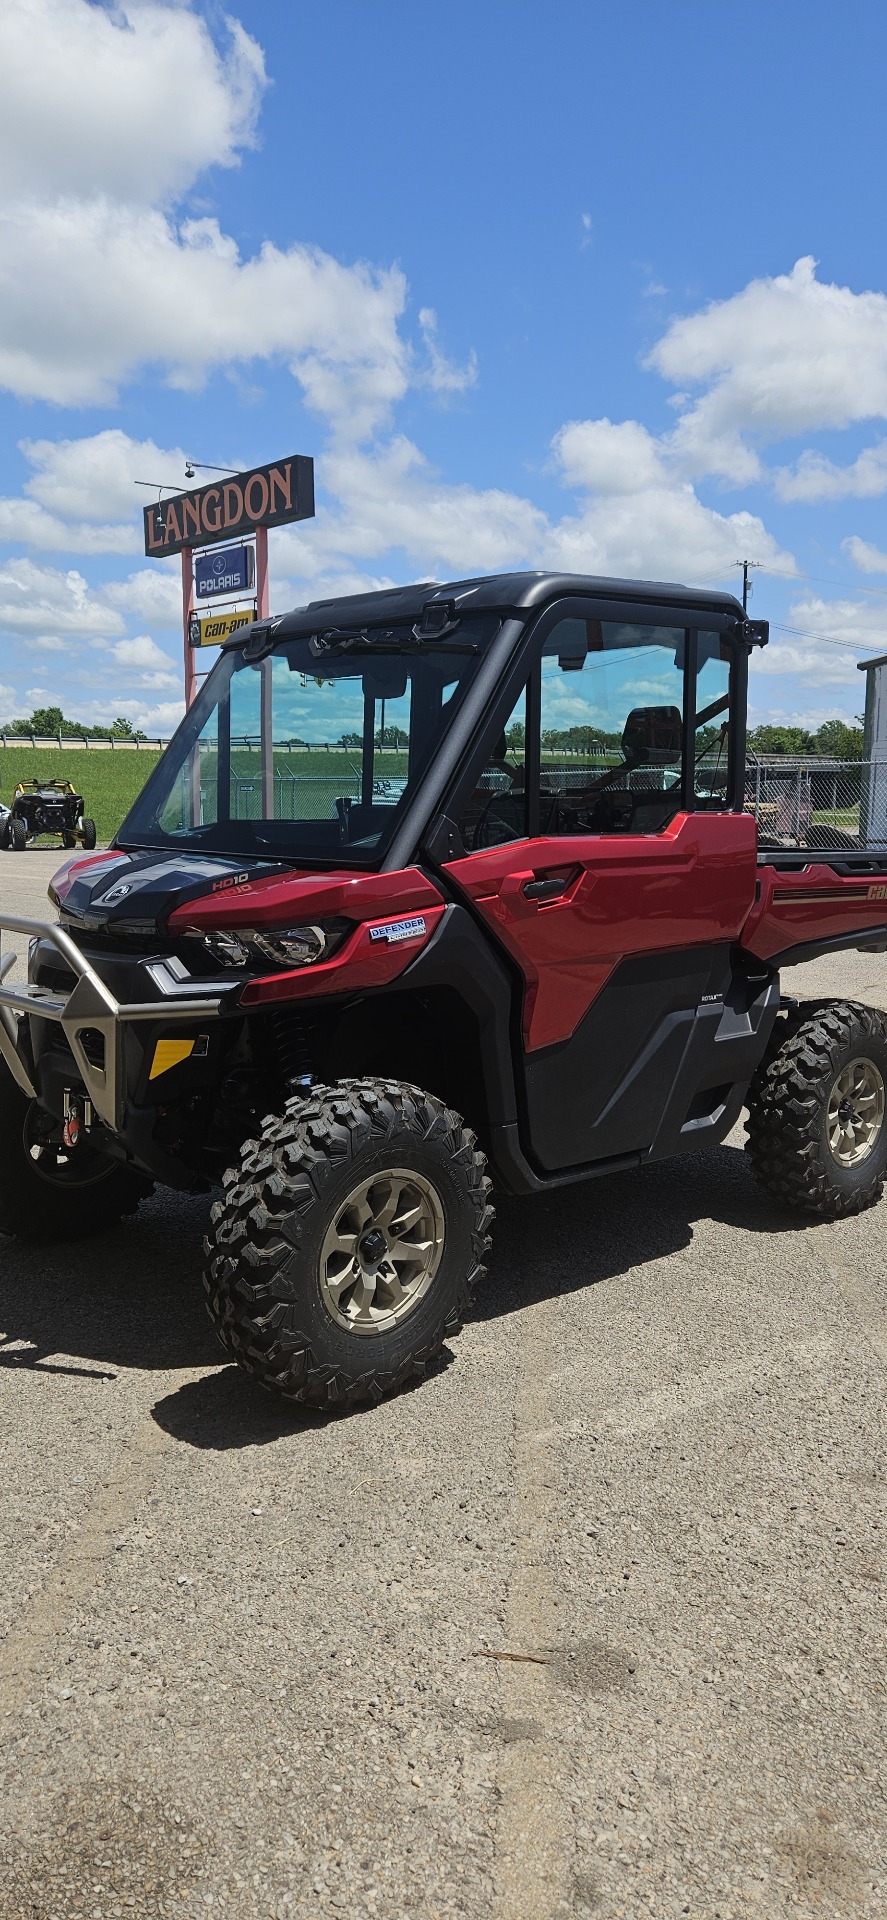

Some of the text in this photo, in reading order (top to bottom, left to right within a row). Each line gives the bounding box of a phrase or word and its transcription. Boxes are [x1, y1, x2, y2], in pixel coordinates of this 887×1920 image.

[147, 464, 292, 550] LANGDON
[199, 572, 241, 593] POLARIS
[212, 873, 249, 891] HD10
[371, 918, 424, 937] DEFENDER
